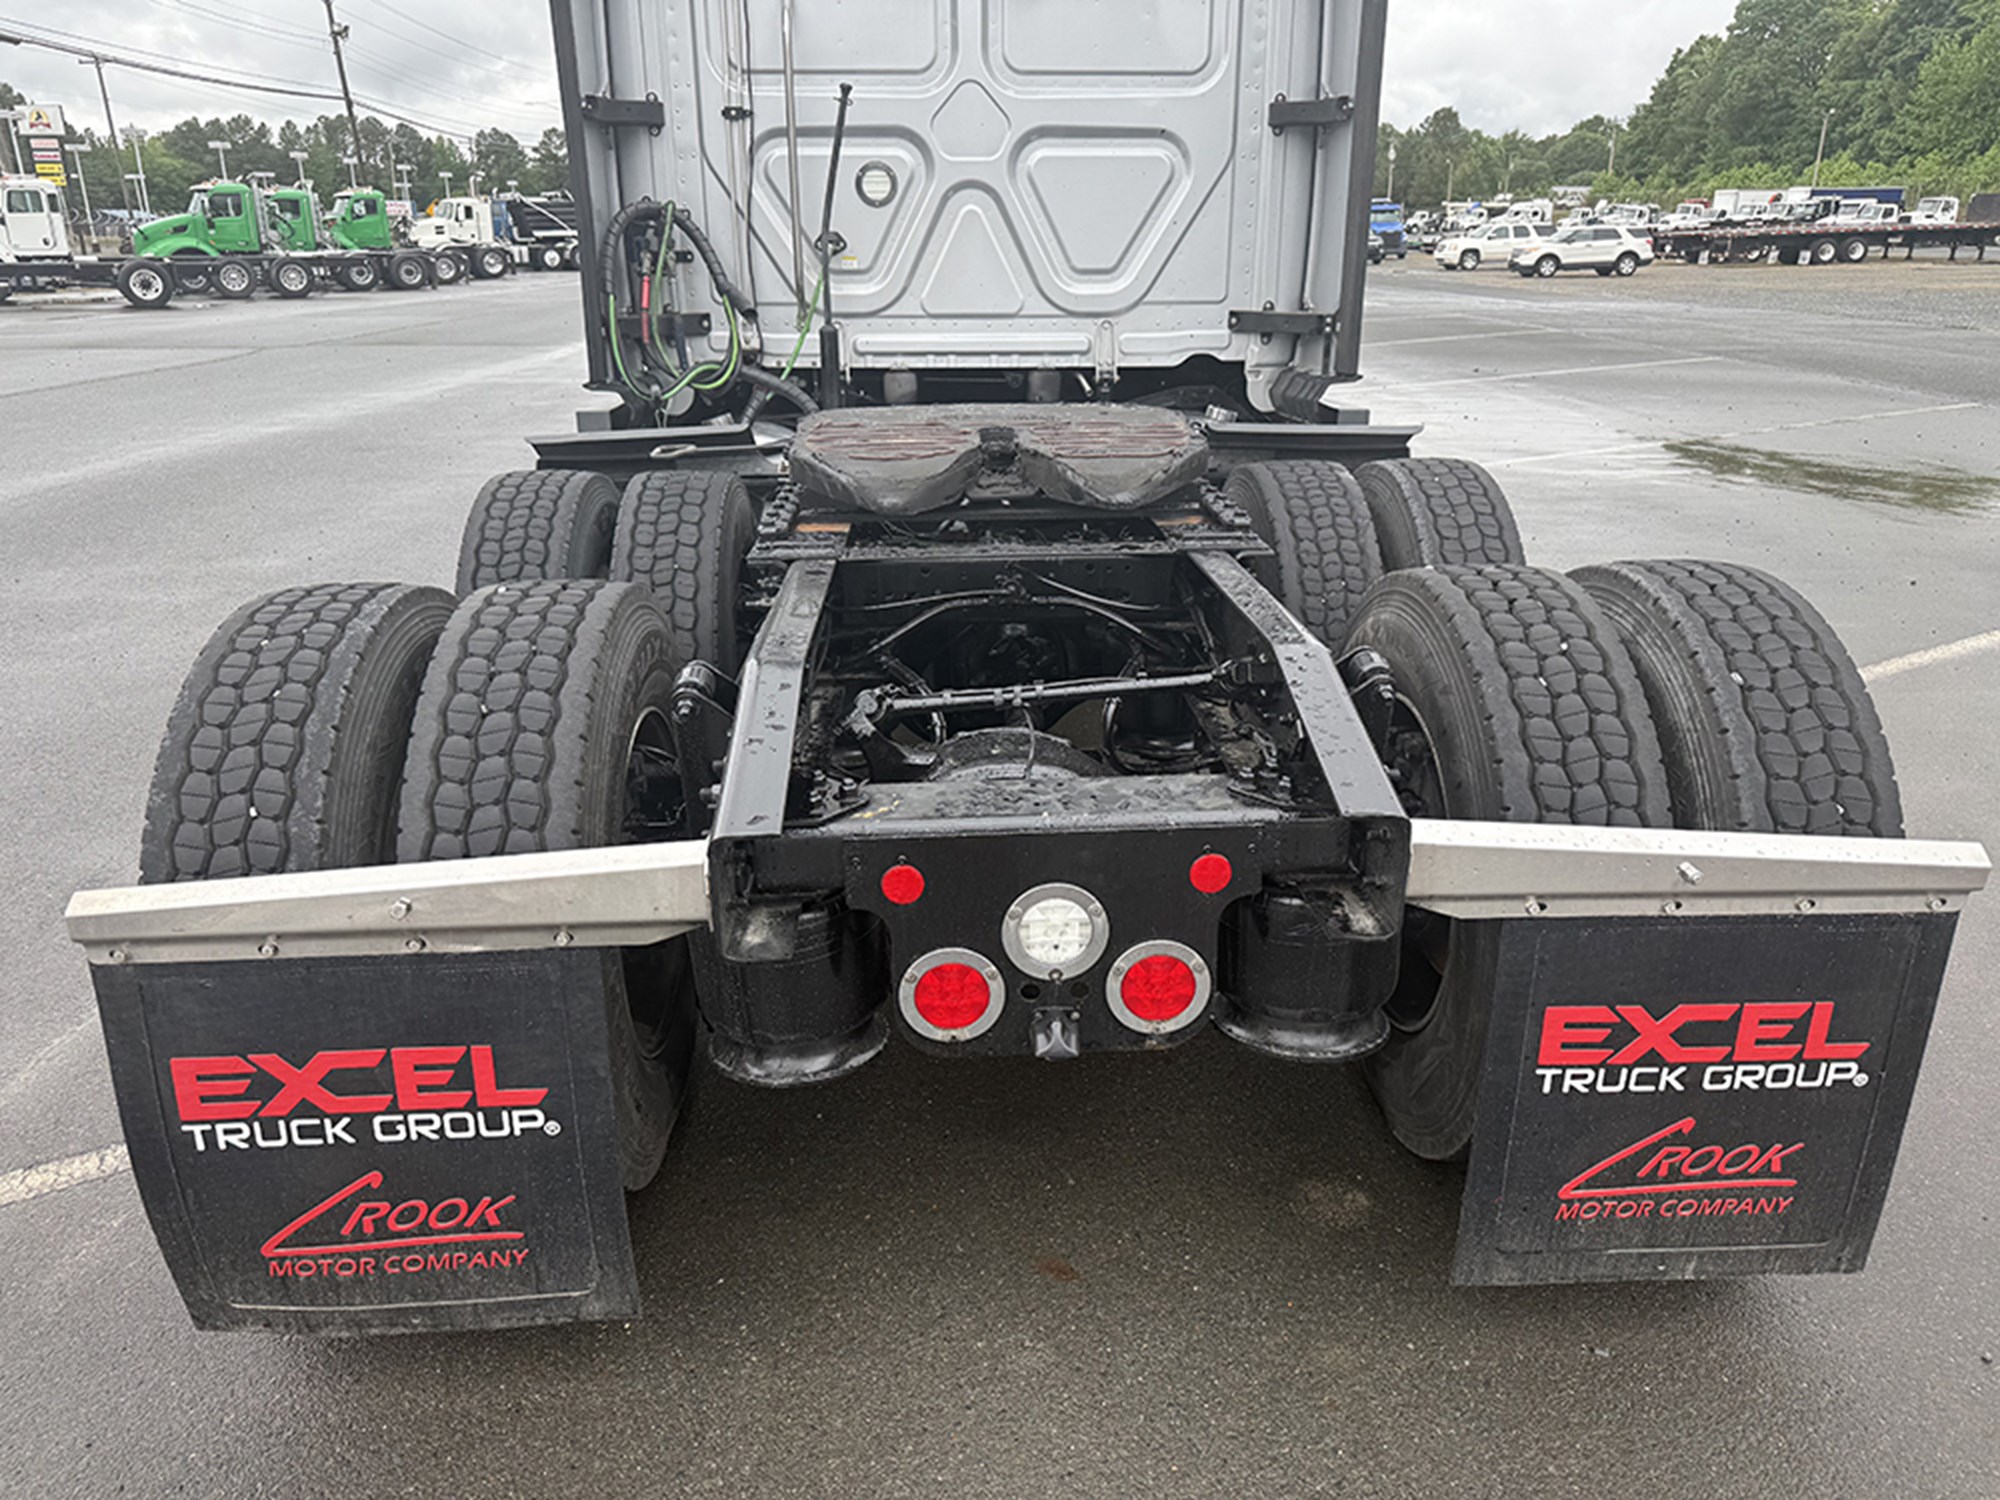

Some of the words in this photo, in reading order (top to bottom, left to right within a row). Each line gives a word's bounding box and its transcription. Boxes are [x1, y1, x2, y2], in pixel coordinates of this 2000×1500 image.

[1537, 1001, 1871, 1067] EXCEL
[169, 1045, 549, 1122] EXCEL
[1535, 1065, 1687, 1094] TRUCK
[180, 1116, 356, 1152] TRUCK
[1557, 1117, 1805, 1201] CROOK
[259, 1171, 525, 1258] CROOK
[1554, 1200, 1655, 1221] MOTOR
[1659, 1196, 1795, 1218] COMPANY
[269, 1258, 376, 1278] MOTOR
[383, 1249, 530, 1274] COMPANY
